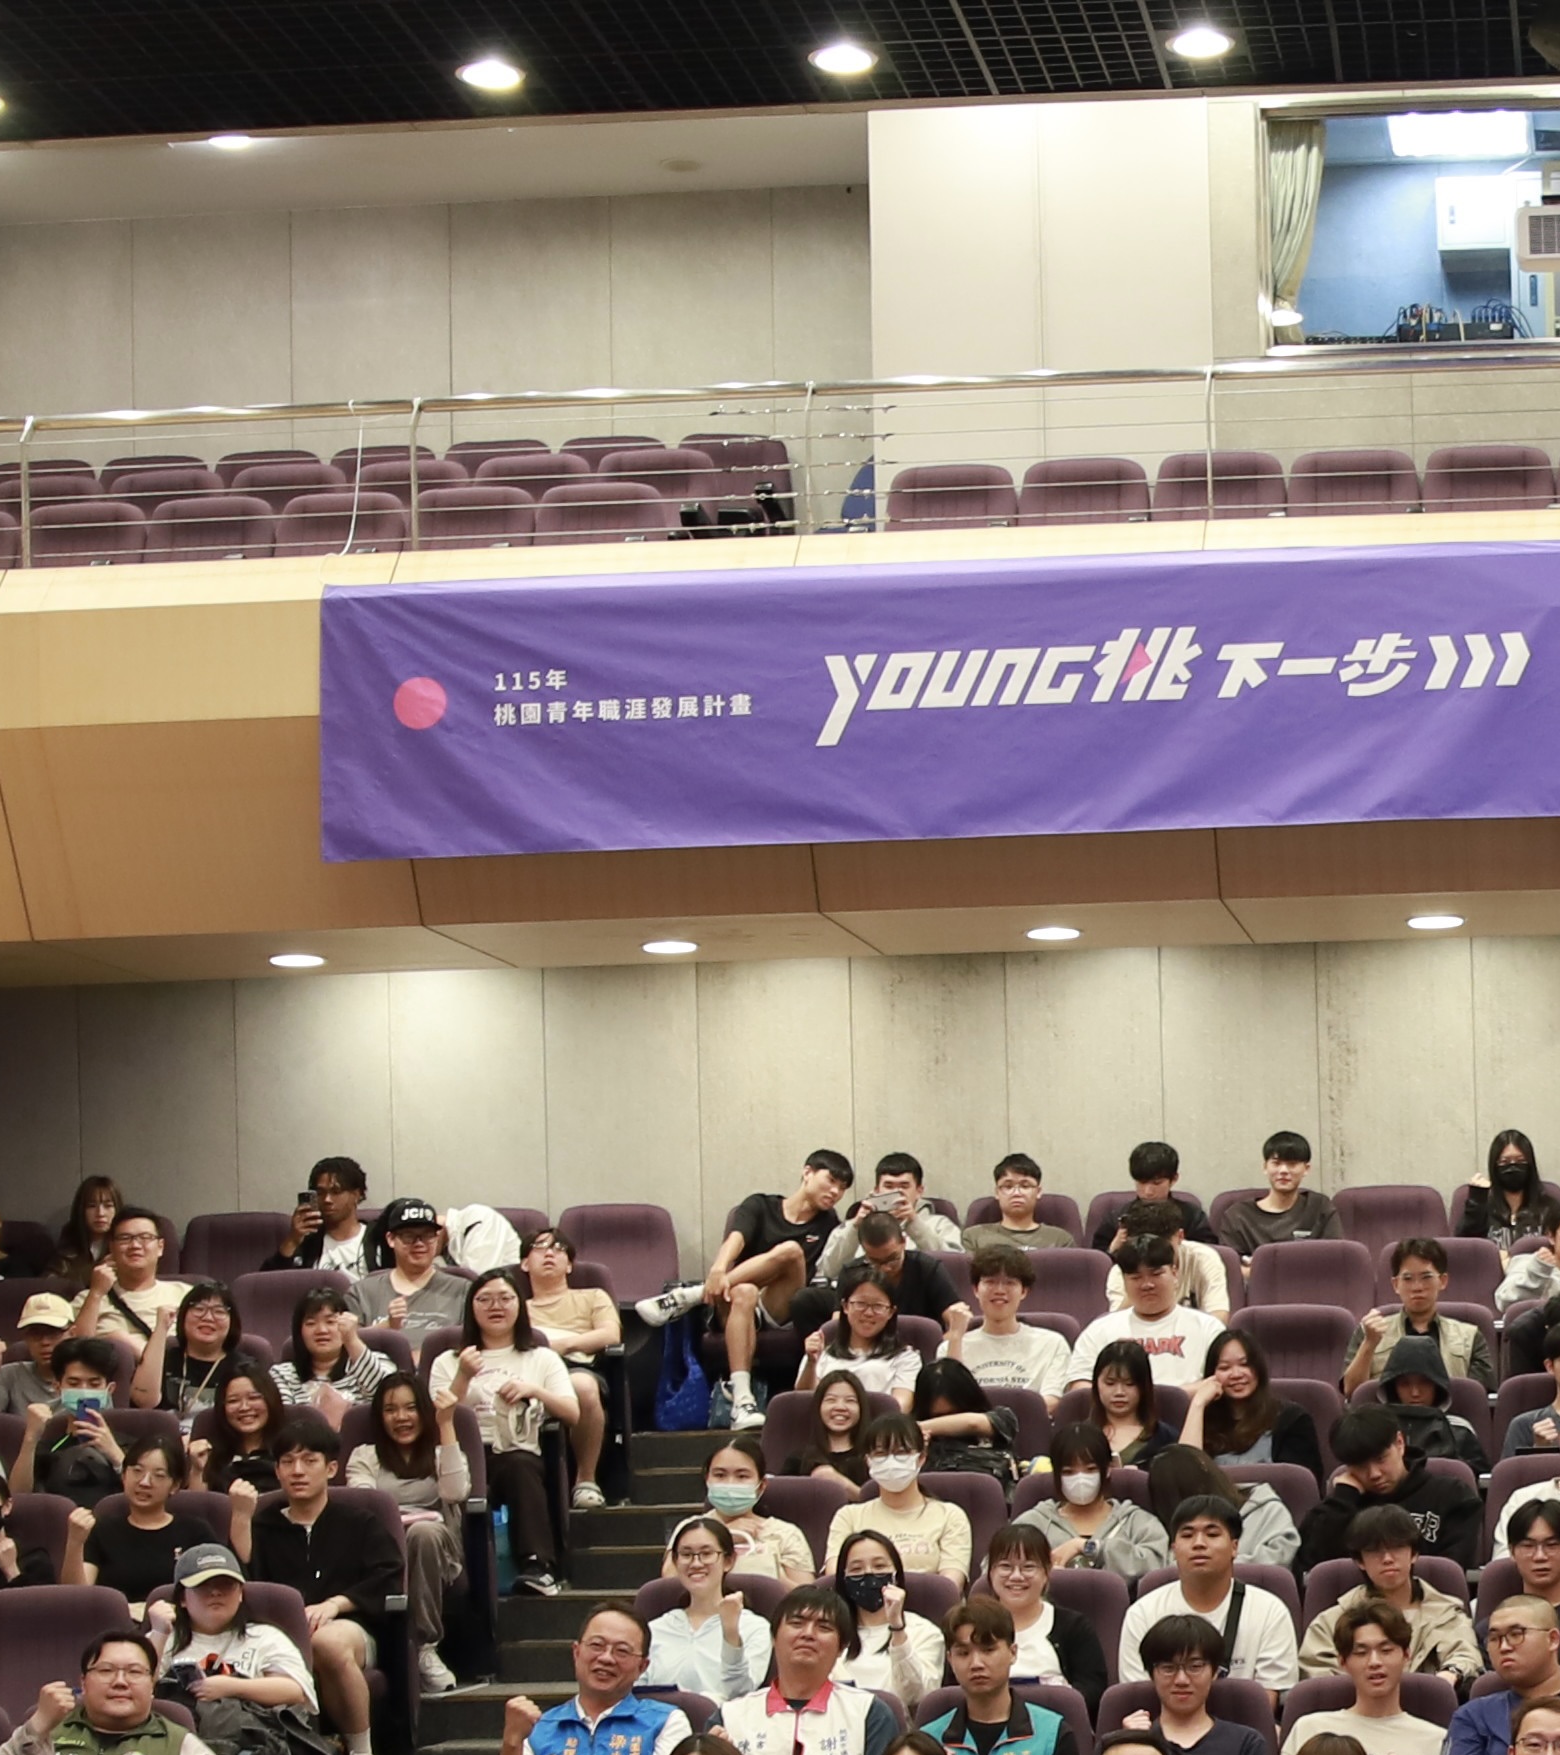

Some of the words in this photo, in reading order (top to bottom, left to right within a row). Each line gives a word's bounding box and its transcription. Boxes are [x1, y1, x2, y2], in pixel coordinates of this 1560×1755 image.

[493, 668, 568, 692] 115年
[1216, 632, 1418, 698] 下一步
[493, 693, 753, 727] 桃園青年職涯發展計畫
